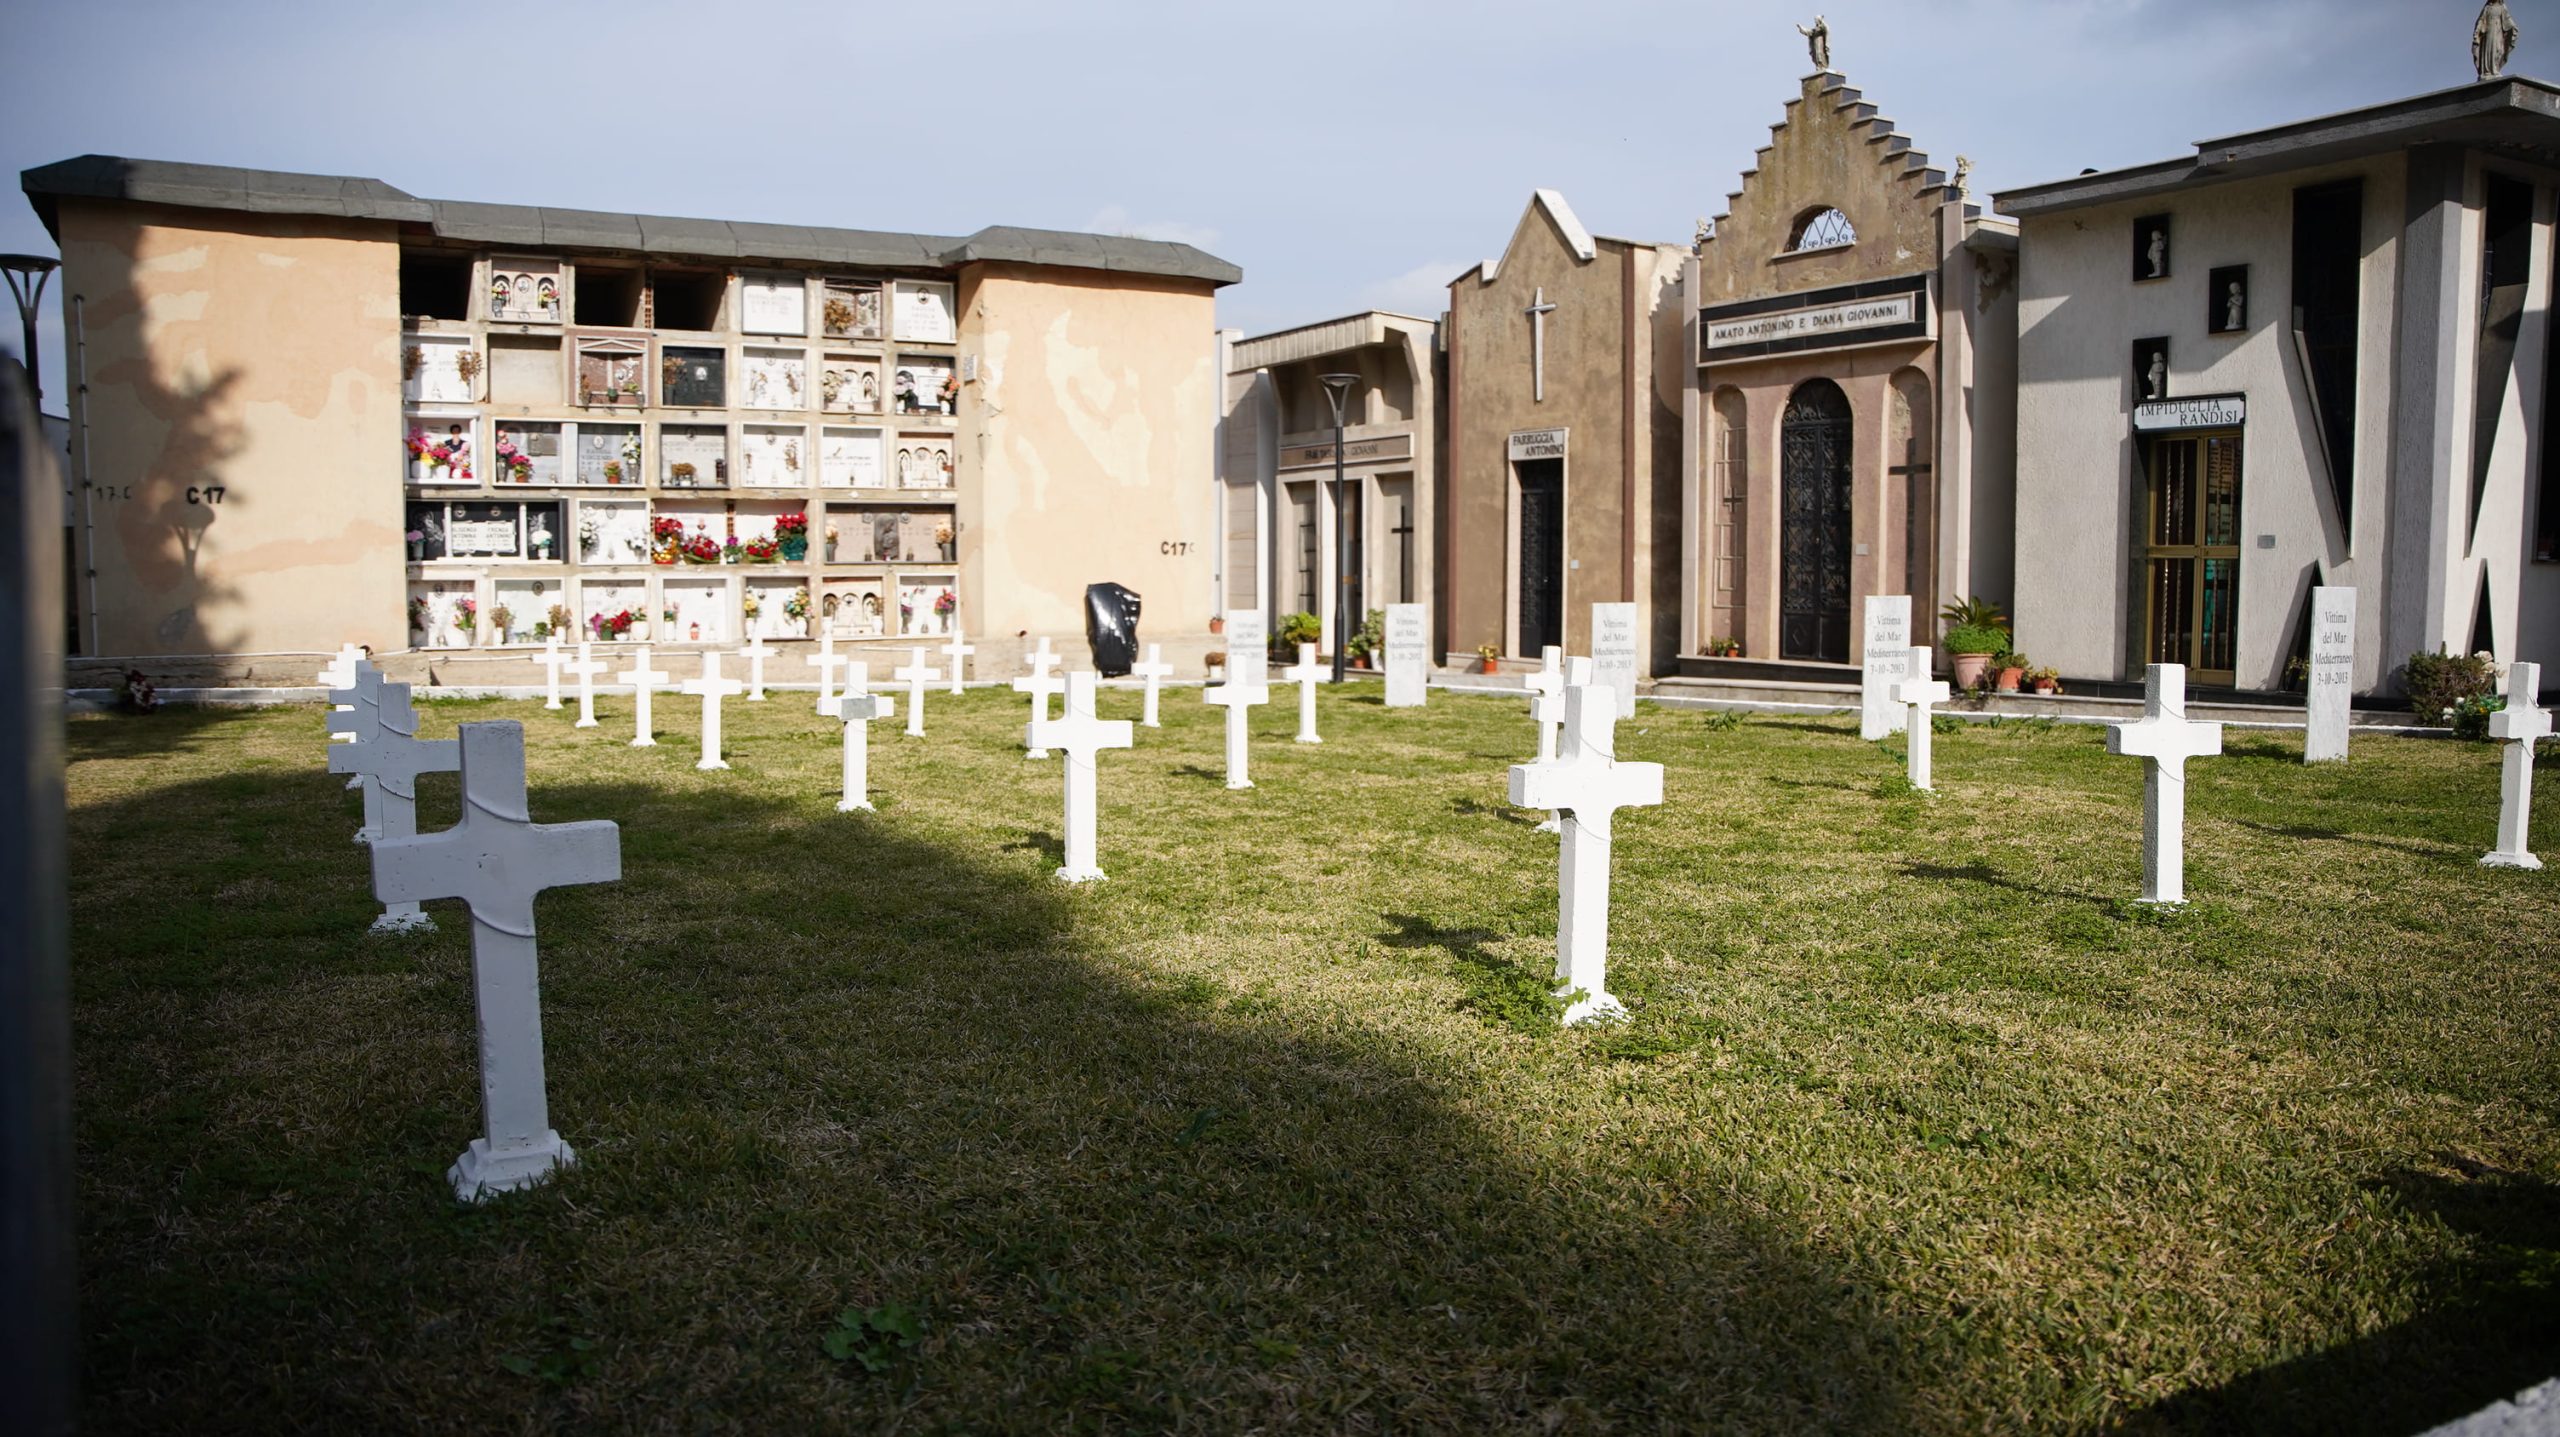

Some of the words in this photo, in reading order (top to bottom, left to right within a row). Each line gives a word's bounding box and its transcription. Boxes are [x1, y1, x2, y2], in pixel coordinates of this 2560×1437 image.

[1714, 326, 1744, 340] AMATO
[1747, 319, 1794, 336] ANTONINO
[1799, 318, 1806, 328] E
[1812, 313, 1843, 327] DIANA
[1847, 304, 1898, 321] GIOVANNI
[2141, 400, 2221, 416] IMPIDUGLIA
[2180, 410, 2237, 426] RANDISI
[1525, 444, 1564, 457] ANTONINO
[1160, 541, 1187, 557] C17
[1876, 615, 1901, 626] Vittima
[2325, 611, 2347, 624] Vittima
[1874, 632, 1886, 642] del
[1887, 632, 1902, 642] Mar
[2323, 633, 2332, 645] del
[2333, 633, 2347, 644] Mar
[2315, 652, 2353, 666] Mediterraneo
